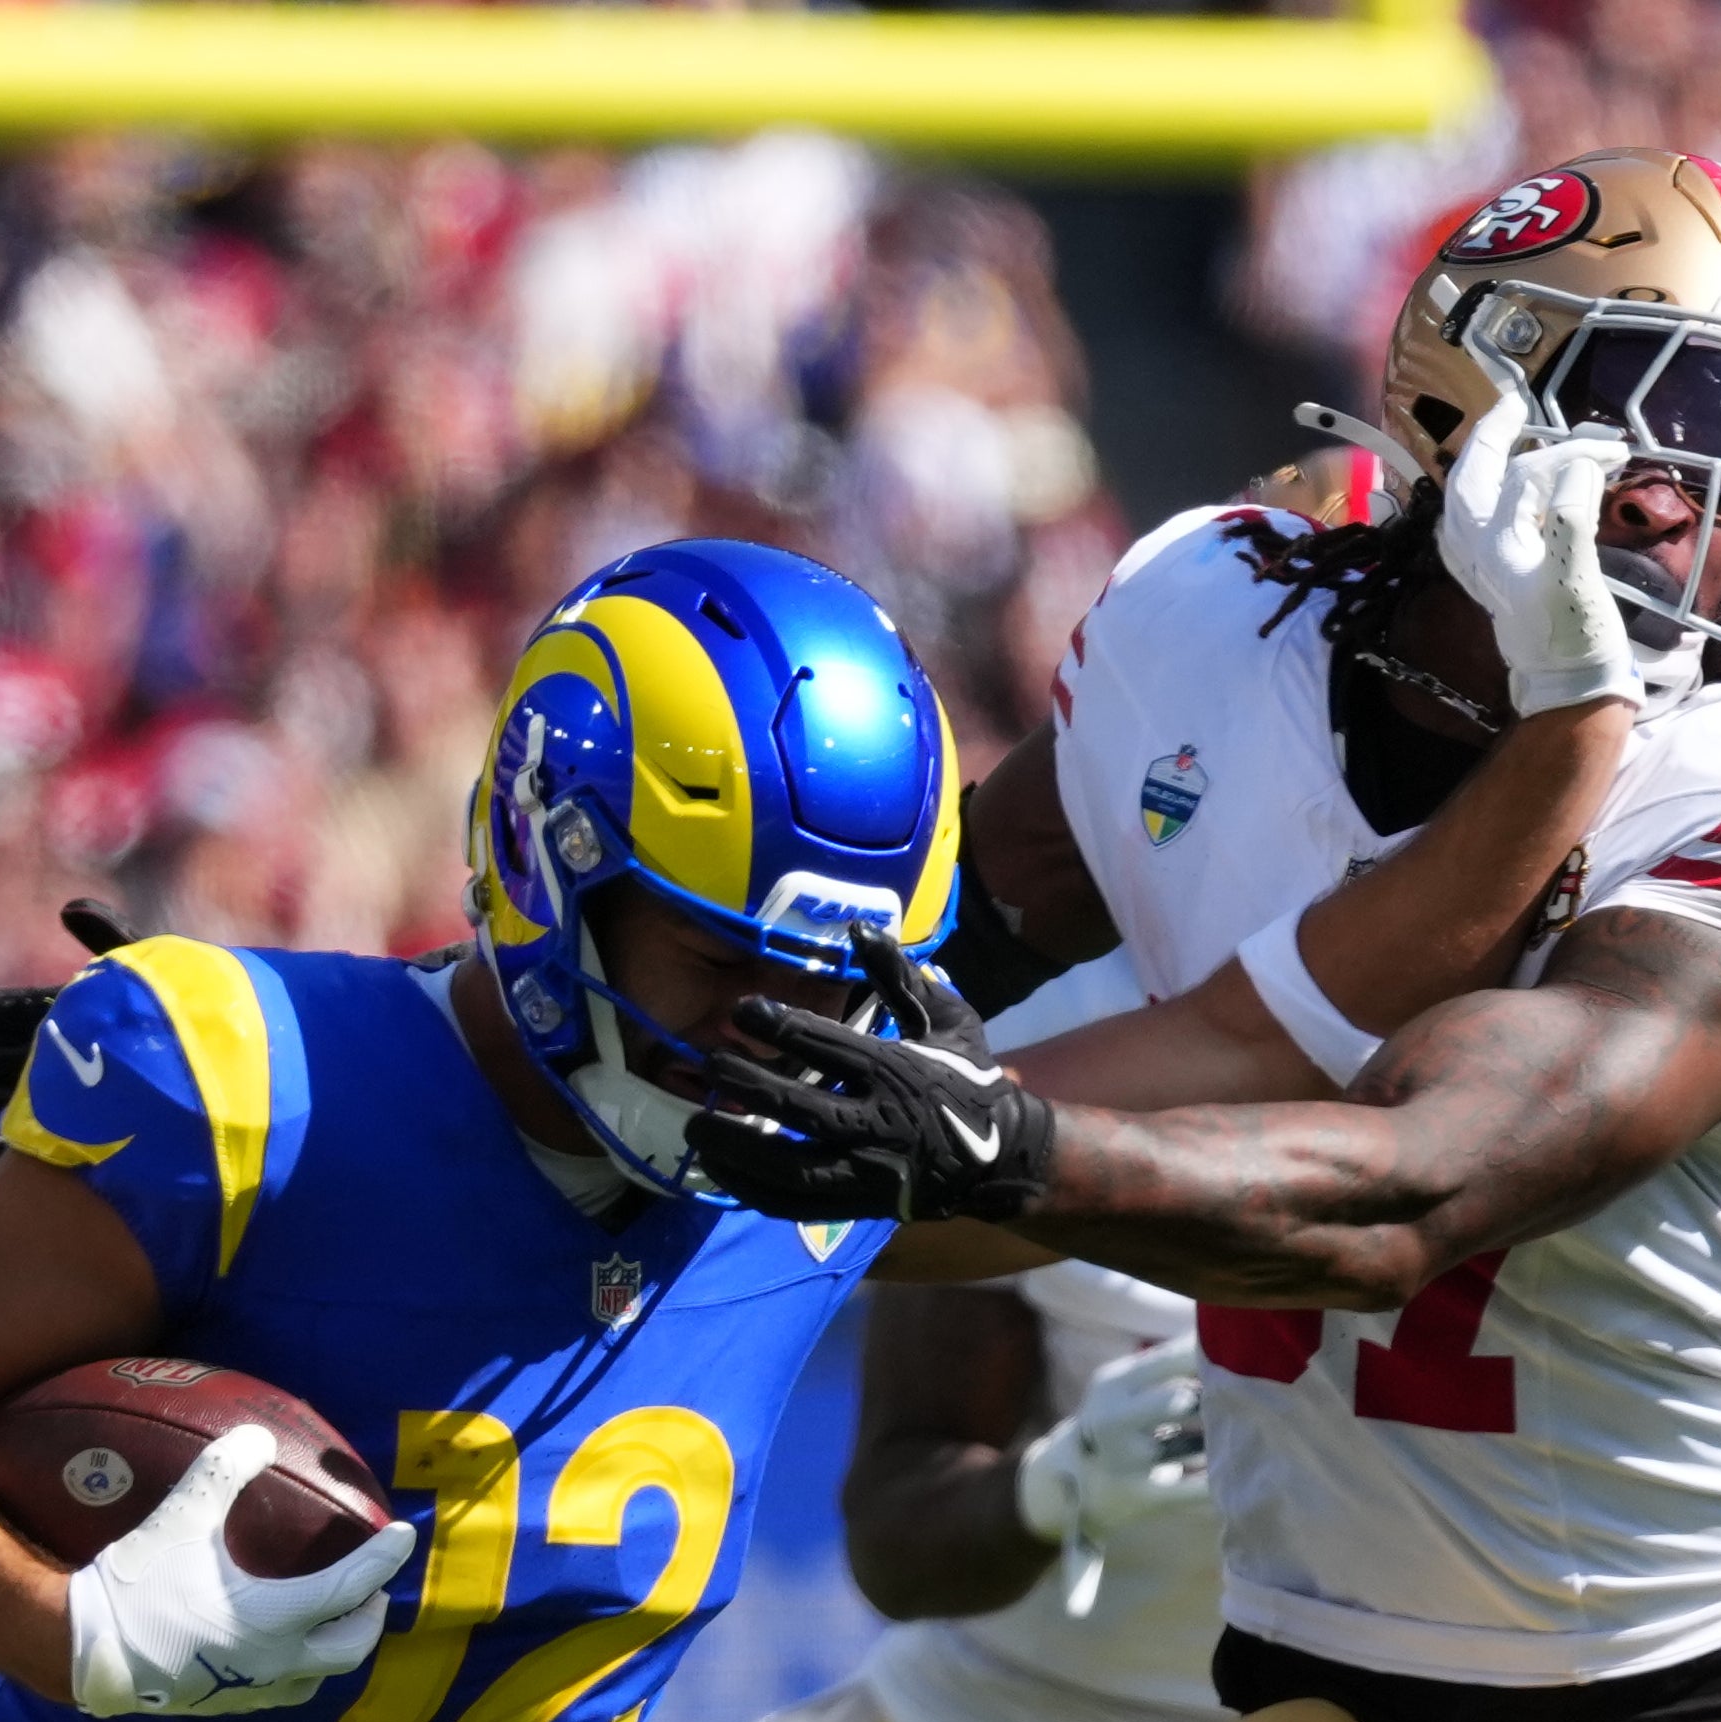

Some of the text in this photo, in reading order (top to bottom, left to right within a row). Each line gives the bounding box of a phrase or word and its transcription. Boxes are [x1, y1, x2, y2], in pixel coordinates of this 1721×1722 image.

[789, 892, 895, 931] RAMS
[599, 1286, 633, 1317] NFL
[120, 1358, 196, 1380] NFL
